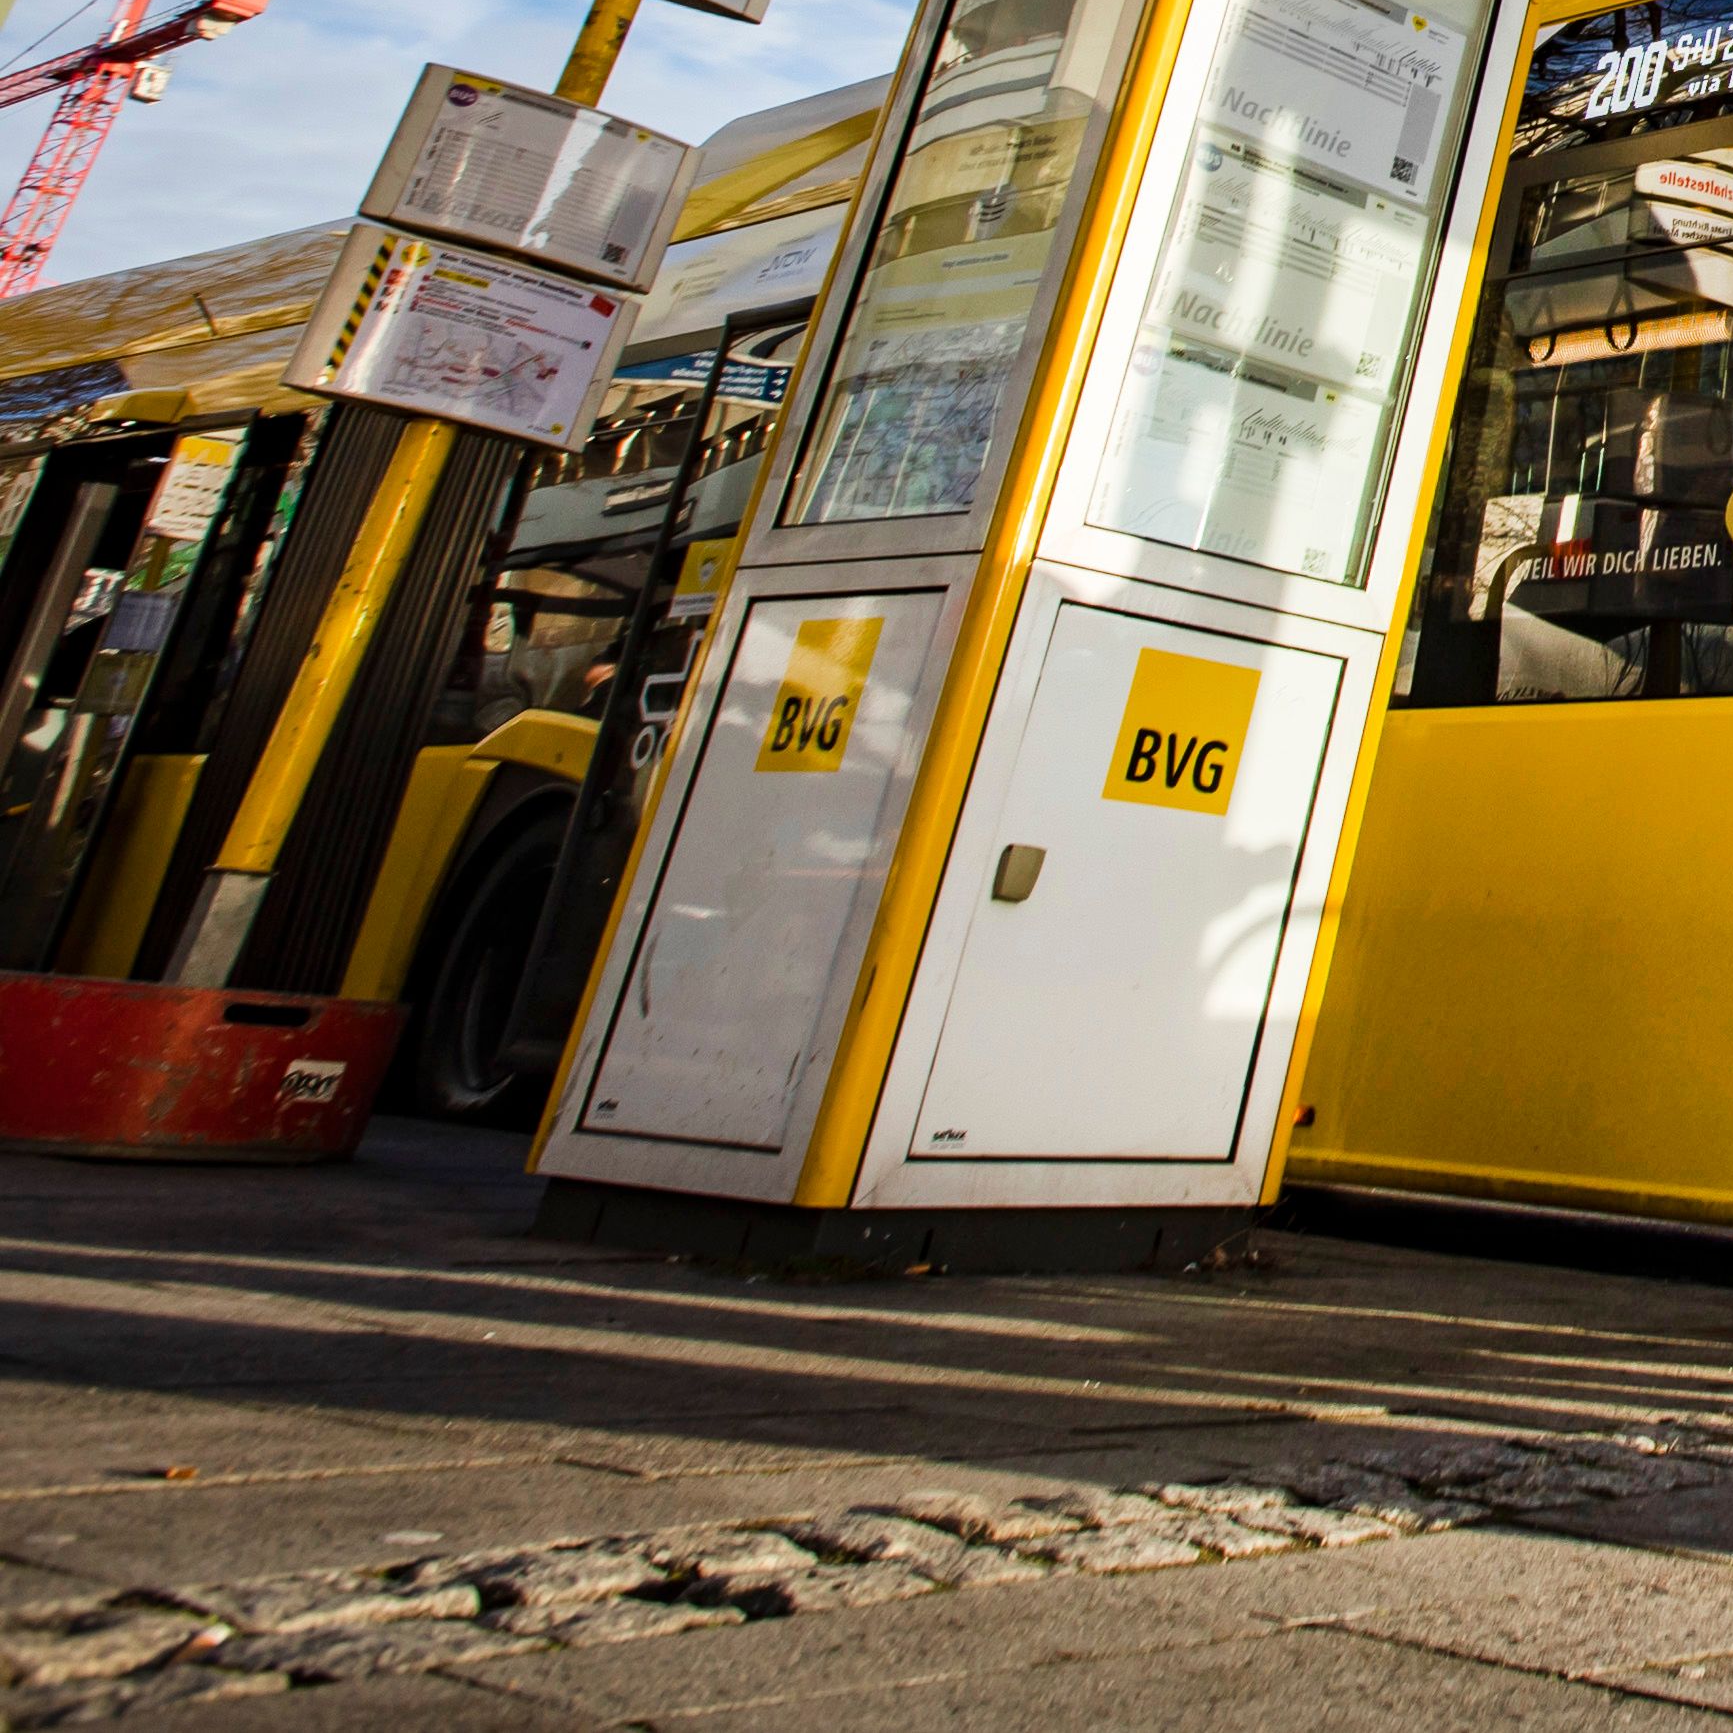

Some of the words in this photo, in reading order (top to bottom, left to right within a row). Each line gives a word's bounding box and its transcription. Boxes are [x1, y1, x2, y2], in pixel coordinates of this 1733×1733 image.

[1585, 39, 1669, 120] 200
[1672, 26, 1722, 72] S+U
[1688, 75, 1720, 98] via
[1563, 552, 1597, 577] WIR
[1602, 549, 1645, 575] DICH
[1652, 543, 1723, 570] LIEBEN.
[770, 694, 850, 754] BVG
[1124, 727, 1231, 796] BVG
